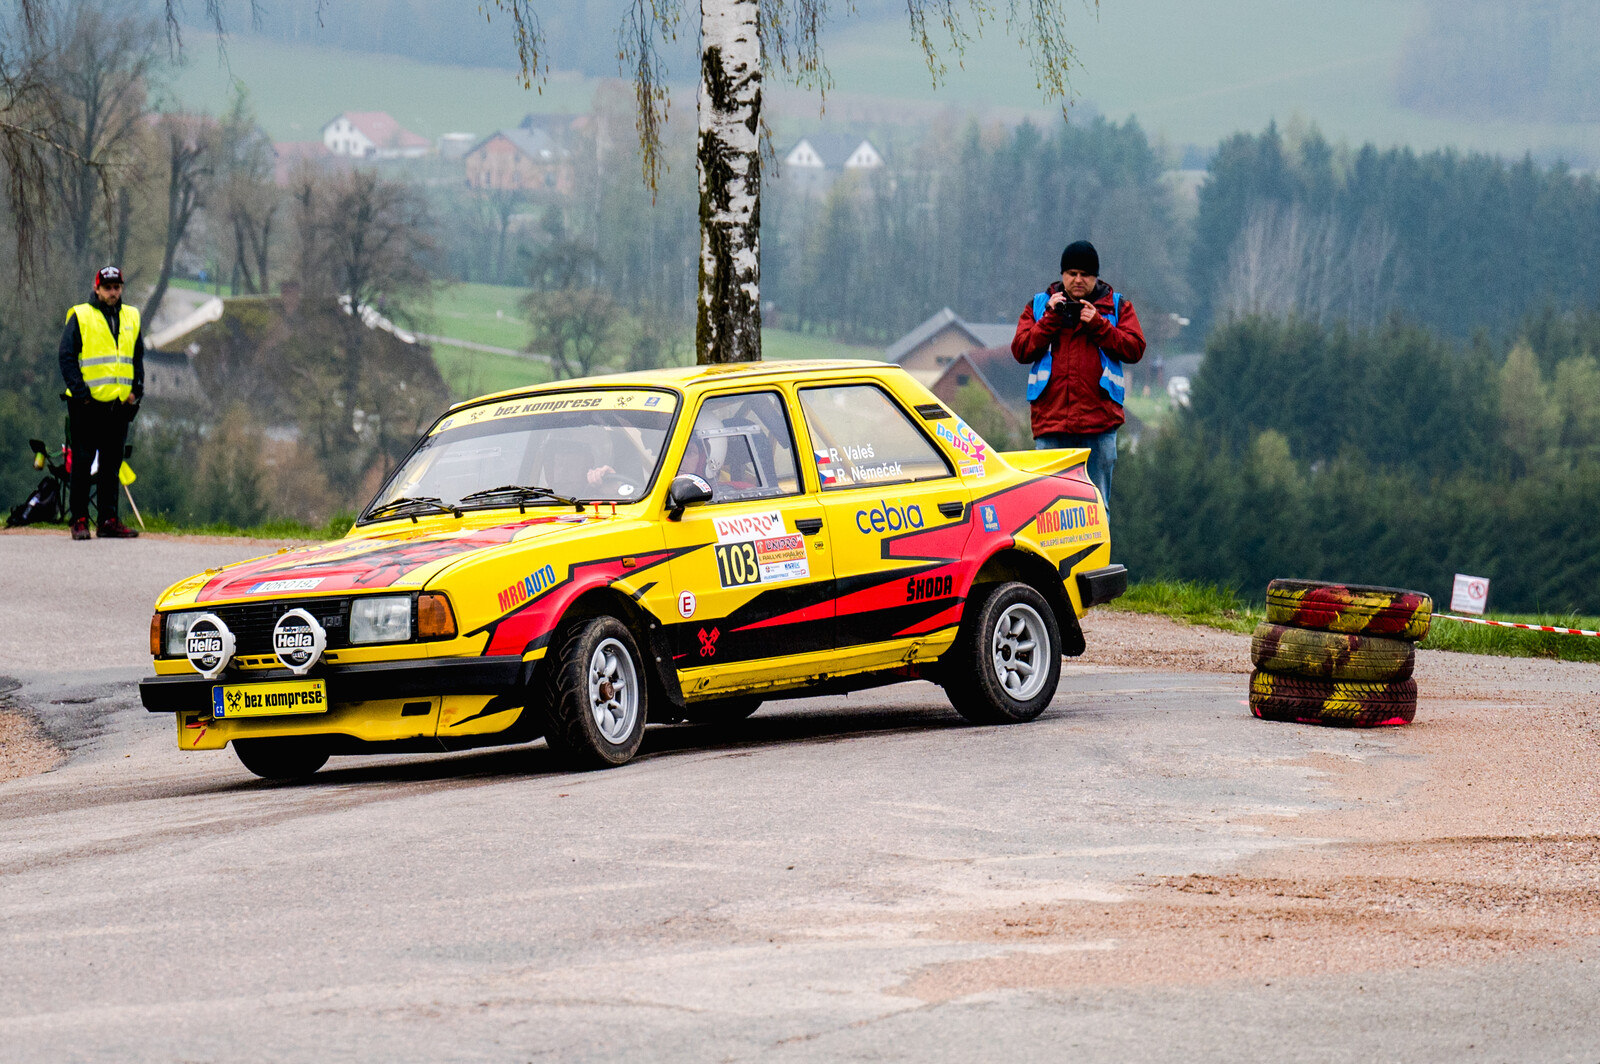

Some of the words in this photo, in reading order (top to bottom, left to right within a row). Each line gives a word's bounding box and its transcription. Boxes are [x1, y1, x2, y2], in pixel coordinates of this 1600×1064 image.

[493, 404, 520, 417] bez
[522, 398, 602, 413] komprese
[829, 447, 843, 463] R.
[847, 443, 875, 461] Valeš
[837, 467, 850, 483] R.
[852, 462, 903, 482] Němeček
[855, 498, 924, 534] cebia
[1036, 504, 1099, 534] MROAUTO.CZ
[717, 543, 759, 585] 103
[497, 564, 556, 613] MROAUTO
[906, 574, 953, 602] ŠKODA
[682, 596, 692, 613] E
[190, 638, 221, 652] Hella
[277, 633, 312, 647] Hella
[244, 691, 263, 708] bez
[265, 690, 322, 709] komprese
